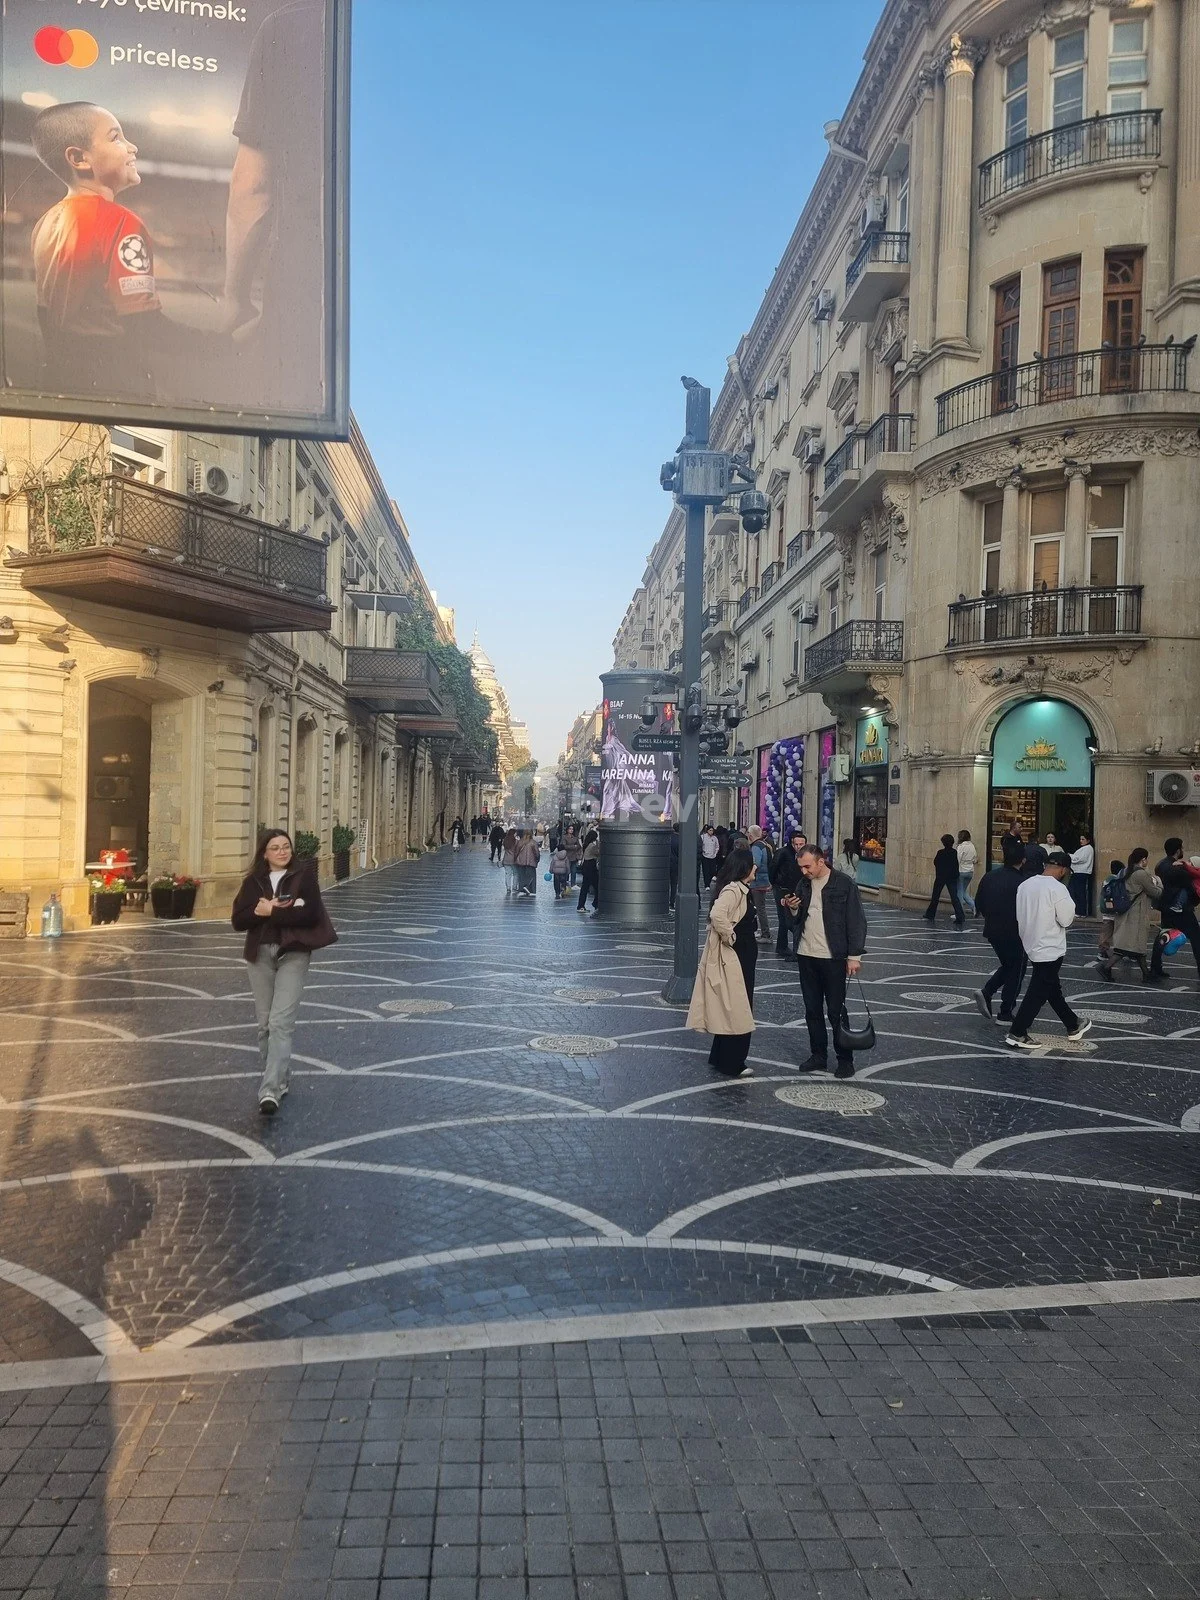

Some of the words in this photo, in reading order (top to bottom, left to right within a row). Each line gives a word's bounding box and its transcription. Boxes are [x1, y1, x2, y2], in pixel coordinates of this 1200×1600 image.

[135, 0, 247, 22] çevirmək:
[110, 43, 218, 73] priceless
[609, 700, 624, 708] BIAF
[618, 753, 655, 765] ANNA
[1015, 759, 1067, 771] CHINAR
[601, 766, 657, 780] KARENİNA
